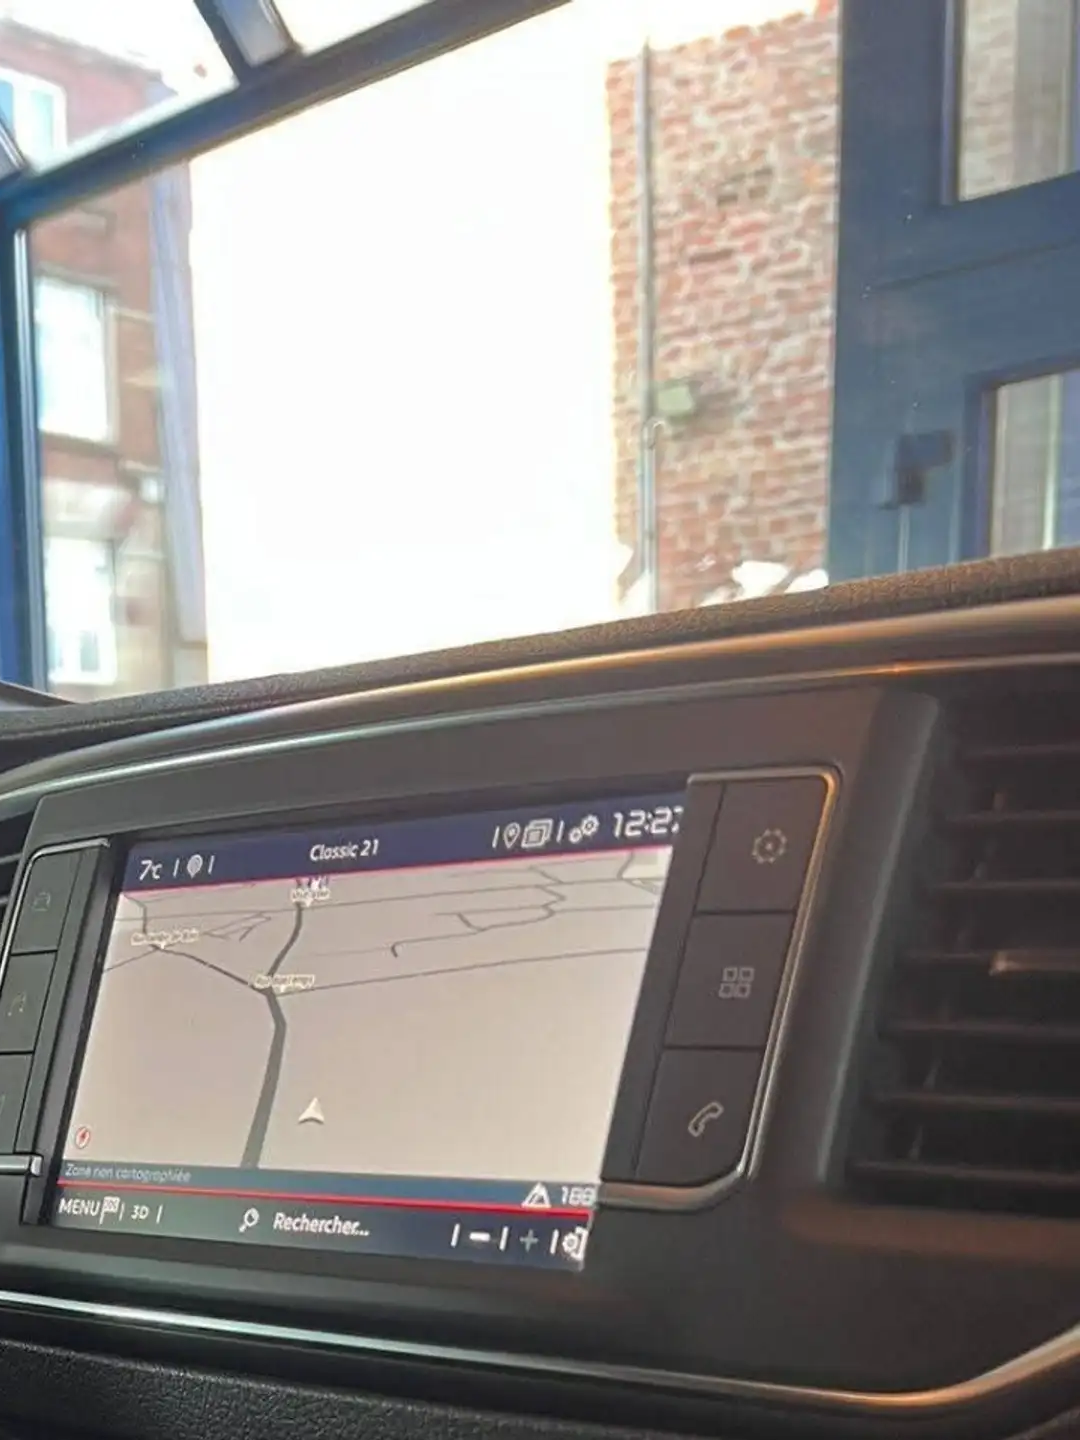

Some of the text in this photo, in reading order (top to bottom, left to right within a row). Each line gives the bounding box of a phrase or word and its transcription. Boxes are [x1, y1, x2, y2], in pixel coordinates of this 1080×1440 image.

[310, 839, 379, 861] Classic 21
[58, 1197, 101, 1217] MENU
[130, 1204, 150, 1220] 3D
